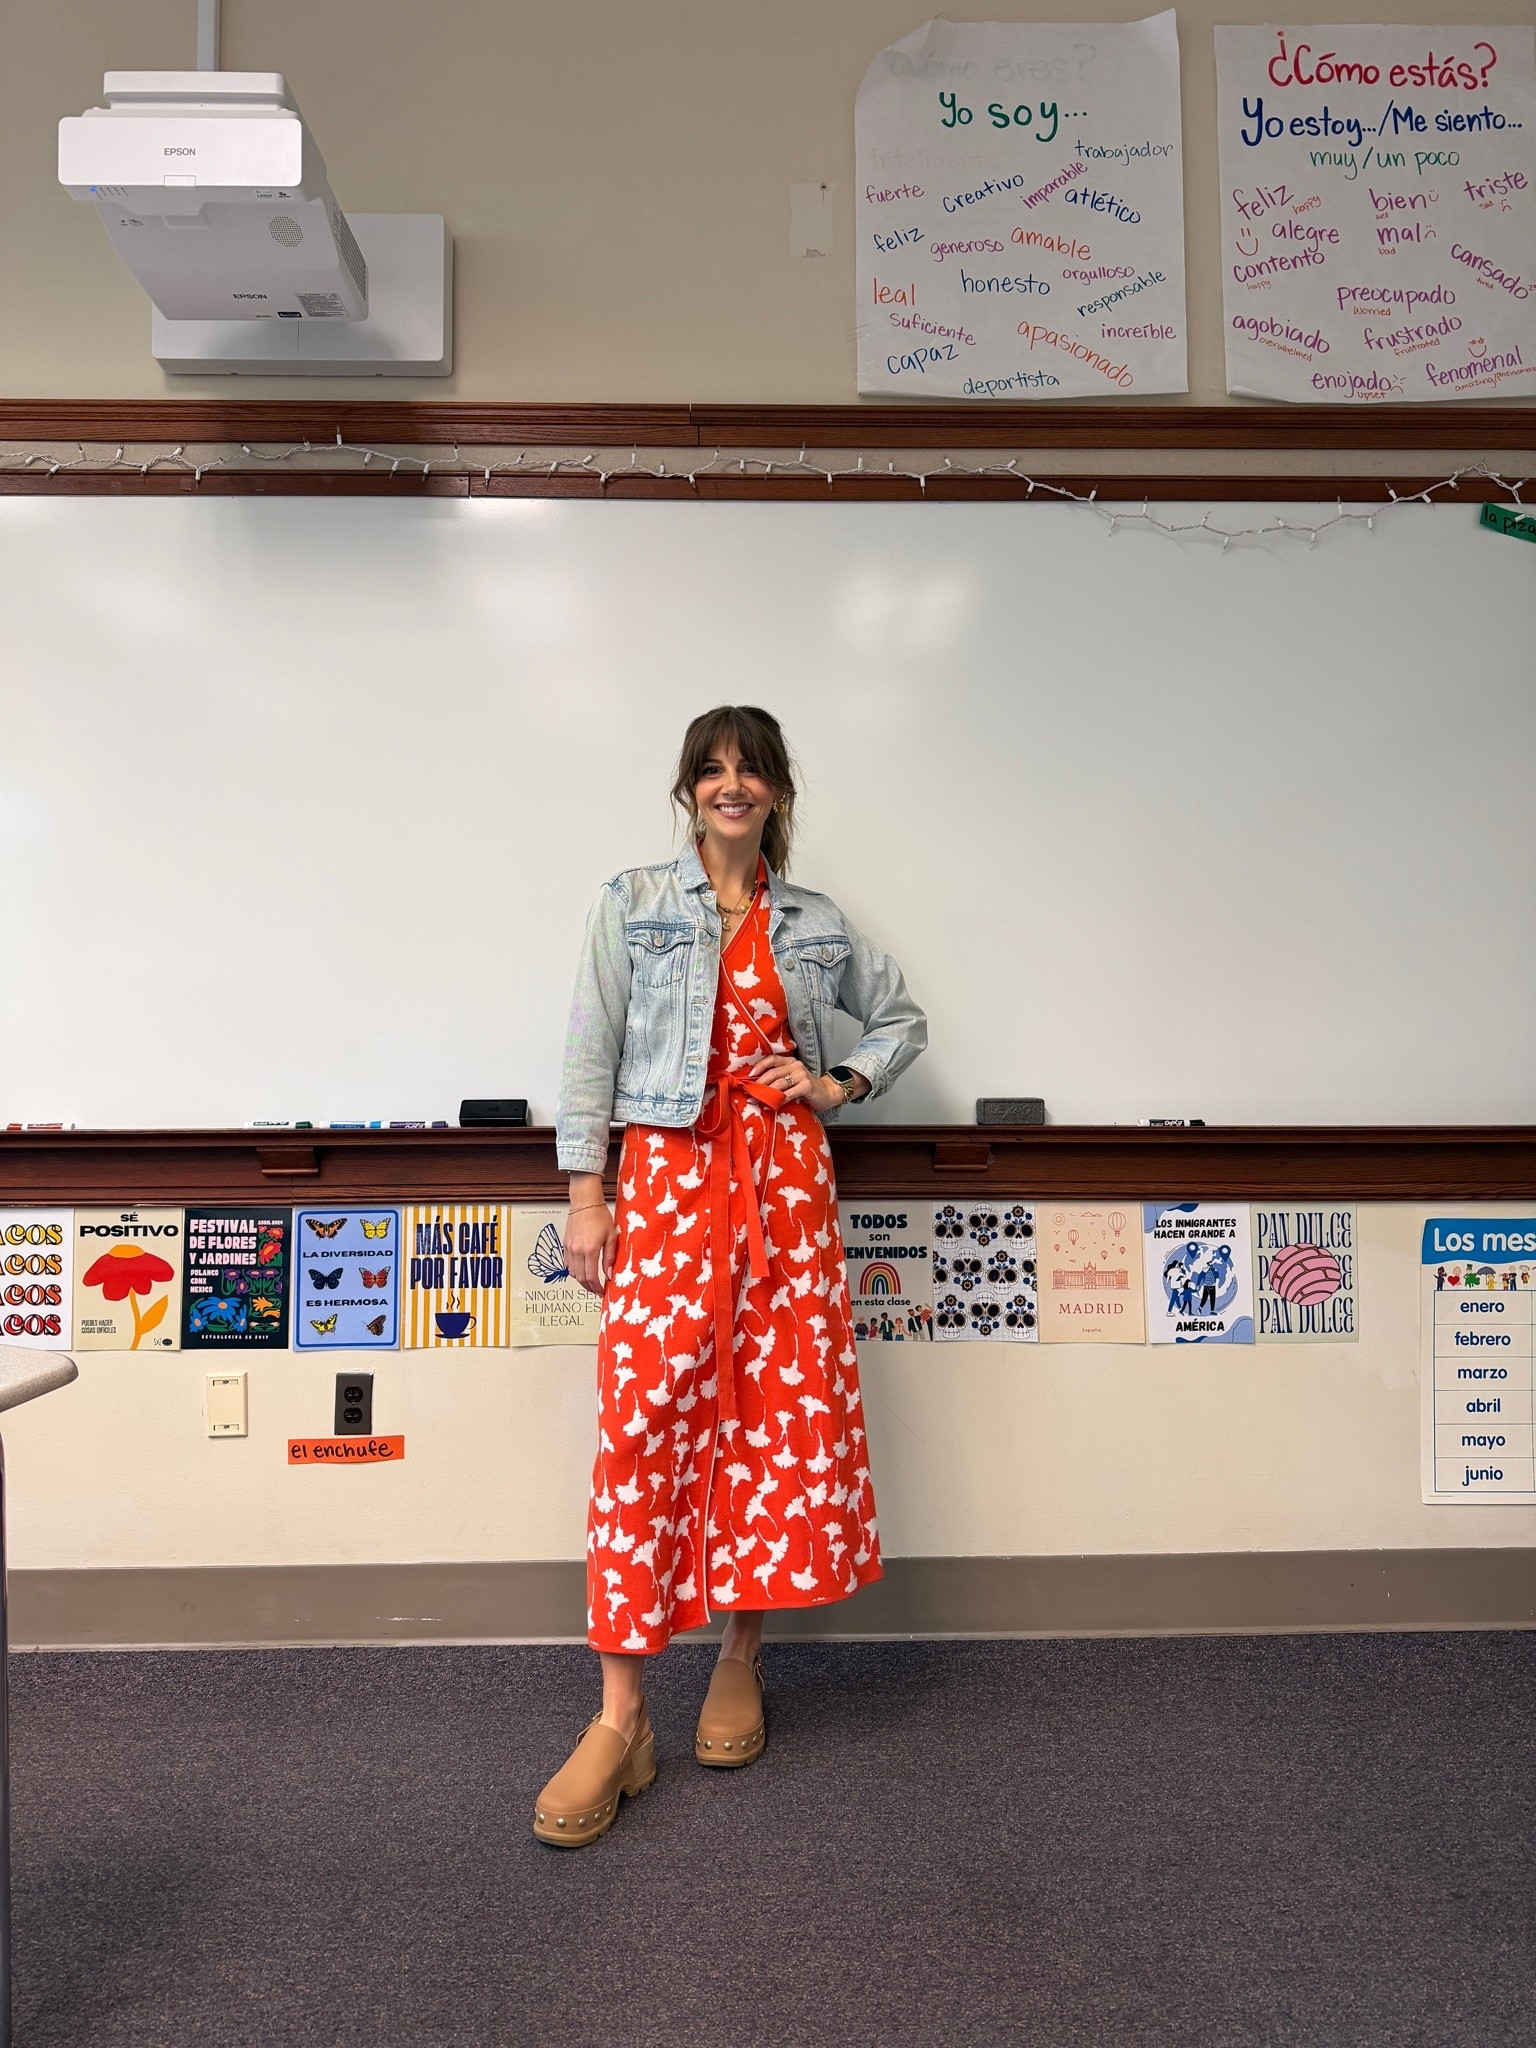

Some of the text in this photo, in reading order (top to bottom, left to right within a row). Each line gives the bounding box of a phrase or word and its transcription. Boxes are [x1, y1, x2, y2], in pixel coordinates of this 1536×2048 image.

[1268, 31, 1497, 90] ¿Cómo estás?
[939, 91, 1088, 142] Yo soy...
[1241, 97, 1284, 147] Yo
[164, 147, 196, 156] EPSON
[1075, 139, 1174, 166] trabajador
[1414, 151, 1460, 176] poco
[866, 183, 925, 203] fuerte
[1020, 159, 1088, 210] imparable
[1463, 171, 1528, 200] triste
[1065, 187, 1141, 224] atlético
[1233, 185, 1295, 220] feliz
[1292, 195, 1321, 215] happy
[1369, 188, 1427, 211] bien
[1479, 200, 1494, 210] sad
[873, 226, 925, 253] feliz
[1011, 226, 1091, 261] amable
[1272, 219, 1340, 253] alegre
[1377, 223, 1421, 245] mal
[930, 240, 1004, 262] generoso
[1378, 247, 1396, 255] bad
[1062, 265, 1135, 286] orgulloso
[1233, 249, 1325, 282] contento
[1451, 244, 1528, 299] cansado
[873, 278, 916, 306] leal
[960, 269, 1051, 295] honesto
[1247, 280, 1272, 291] happy
[1476, 277, 1494, 289] tired
[1077, 269, 1167, 317] responsable
[1337, 284, 1456, 314] preocupado
[889, 312, 976, 346] suficiente
[1101, 323, 1177, 340] increíble
[1232, 315, 1330, 353] agobiado
[1364, 316, 1462, 350] frustrado
[1017, 320, 1134, 388] apasionado
[1259, 337, 1312, 362] overwhelmed
[1394, 337, 1440, 356] frustrated
[887, 344, 960, 375] capaz
[1426, 344, 1523, 386] fenomenal
[963, 369, 1060, 397] deportista
[1310, 370, 1392, 398] enojado
[1485, 505, 1498, 525] la
[120, 1212, 139, 1222] SÉ
[190, 1219, 257, 1233] FESTIVAL
[850, 1214, 908, 1229] TODOS
[1155, 1218, 1237, 1228] LOS INMIGRANTES
[0, 1224, 62, 1245] COS
[80, 1225, 179, 1237] POSITIVO
[416, 1215, 498, 1255] MÁS CAFÉ
[869, 1233, 891, 1241] son
[1154, 1229, 1236, 1239] HACEN GRANDE A
[1256, 1212, 1352, 1248] PAN DULCE
[1434, 1227, 1475, 1252] Los
[189, 1236, 257, 1249] DE FLORES
[843, 1246, 928, 1259] ENVENIDOS
[0, 1254, 62, 1275] COS
[189, 1253, 257, 1265] Y JARDINES
[321, 1250, 394, 1258] DIVERSIDAD
[410, 1257, 503, 1289] POR FAVOR
[0, 1284, 62, 1306] COS
[306, 1298, 389, 1307] ES HERMOSA
[525, 1288, 574, 1301] NINGÚN
[864, 1298, 885, 1306] esta
[887, 1297, 911, 1306] clase
[526, 1302, 602, 1314] HUMANO ES
[1059, 1303, 1125, 1315] MADRID
[1259, 1297, 1354, 1334] PAN DULCE
[1460, 1302, 1505, 1313] enero
[0, 1314, 61, 1336] COS
[540, 1315, 584, 1326] ILEGAL
[1175, 1318, 1225, 1332] AMÉRICA
[1454, 1331, 1511, 1346] febrero
[1457, 1368, 1508, 1379] marzo
[1466, 1398, 1501, 1412] abril
[291, 1440, 394, 1458] el enchufe
[1461, 1435, 1506, 1450] mayo
[1462, 1465, 1504, 1486] junio
